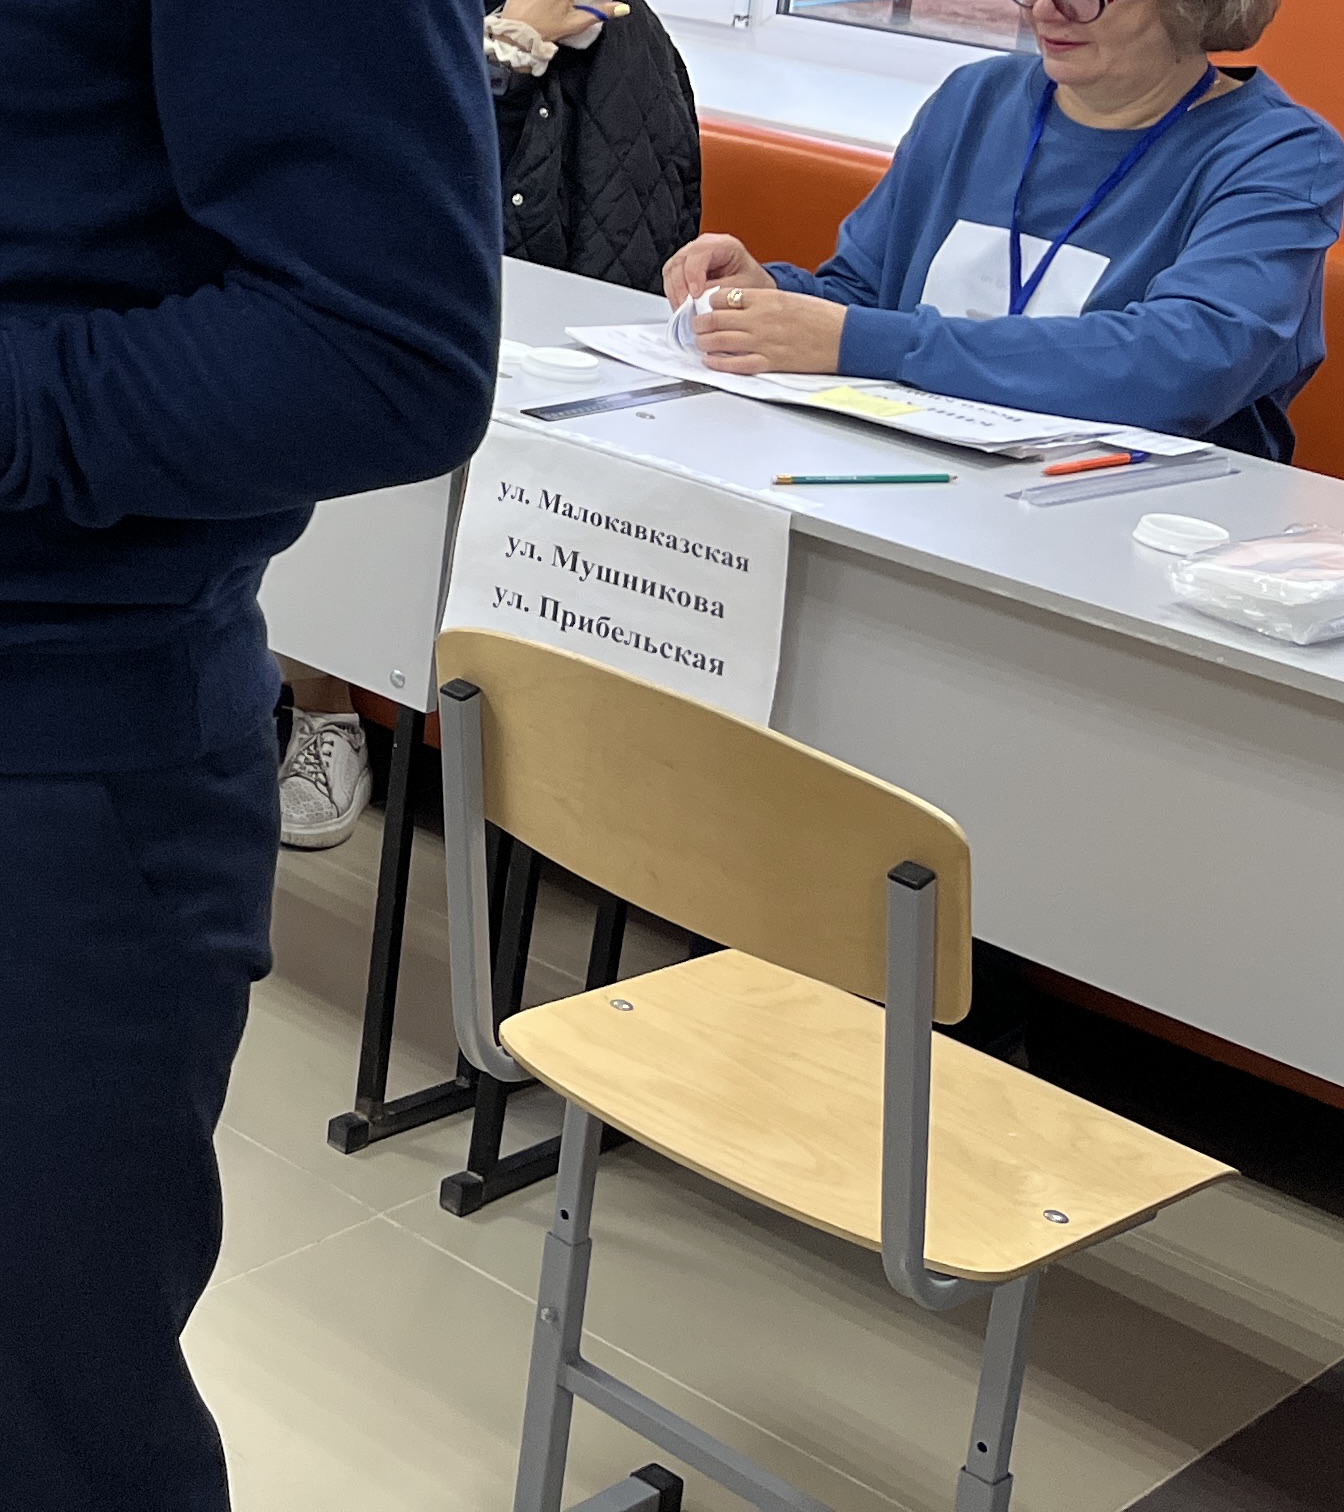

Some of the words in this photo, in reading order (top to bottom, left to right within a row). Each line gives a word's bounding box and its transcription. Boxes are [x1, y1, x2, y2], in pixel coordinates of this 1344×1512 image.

[497, 480, 531, 505] ул.
[538, 489, 751, 573] Малокавказская
[505, 534, 543, 562] ул.
[551, 545, 726, 619] Мушникова
[492, 585, 530, 613] ул.
[539, 594, 726, 677] Прибельская
